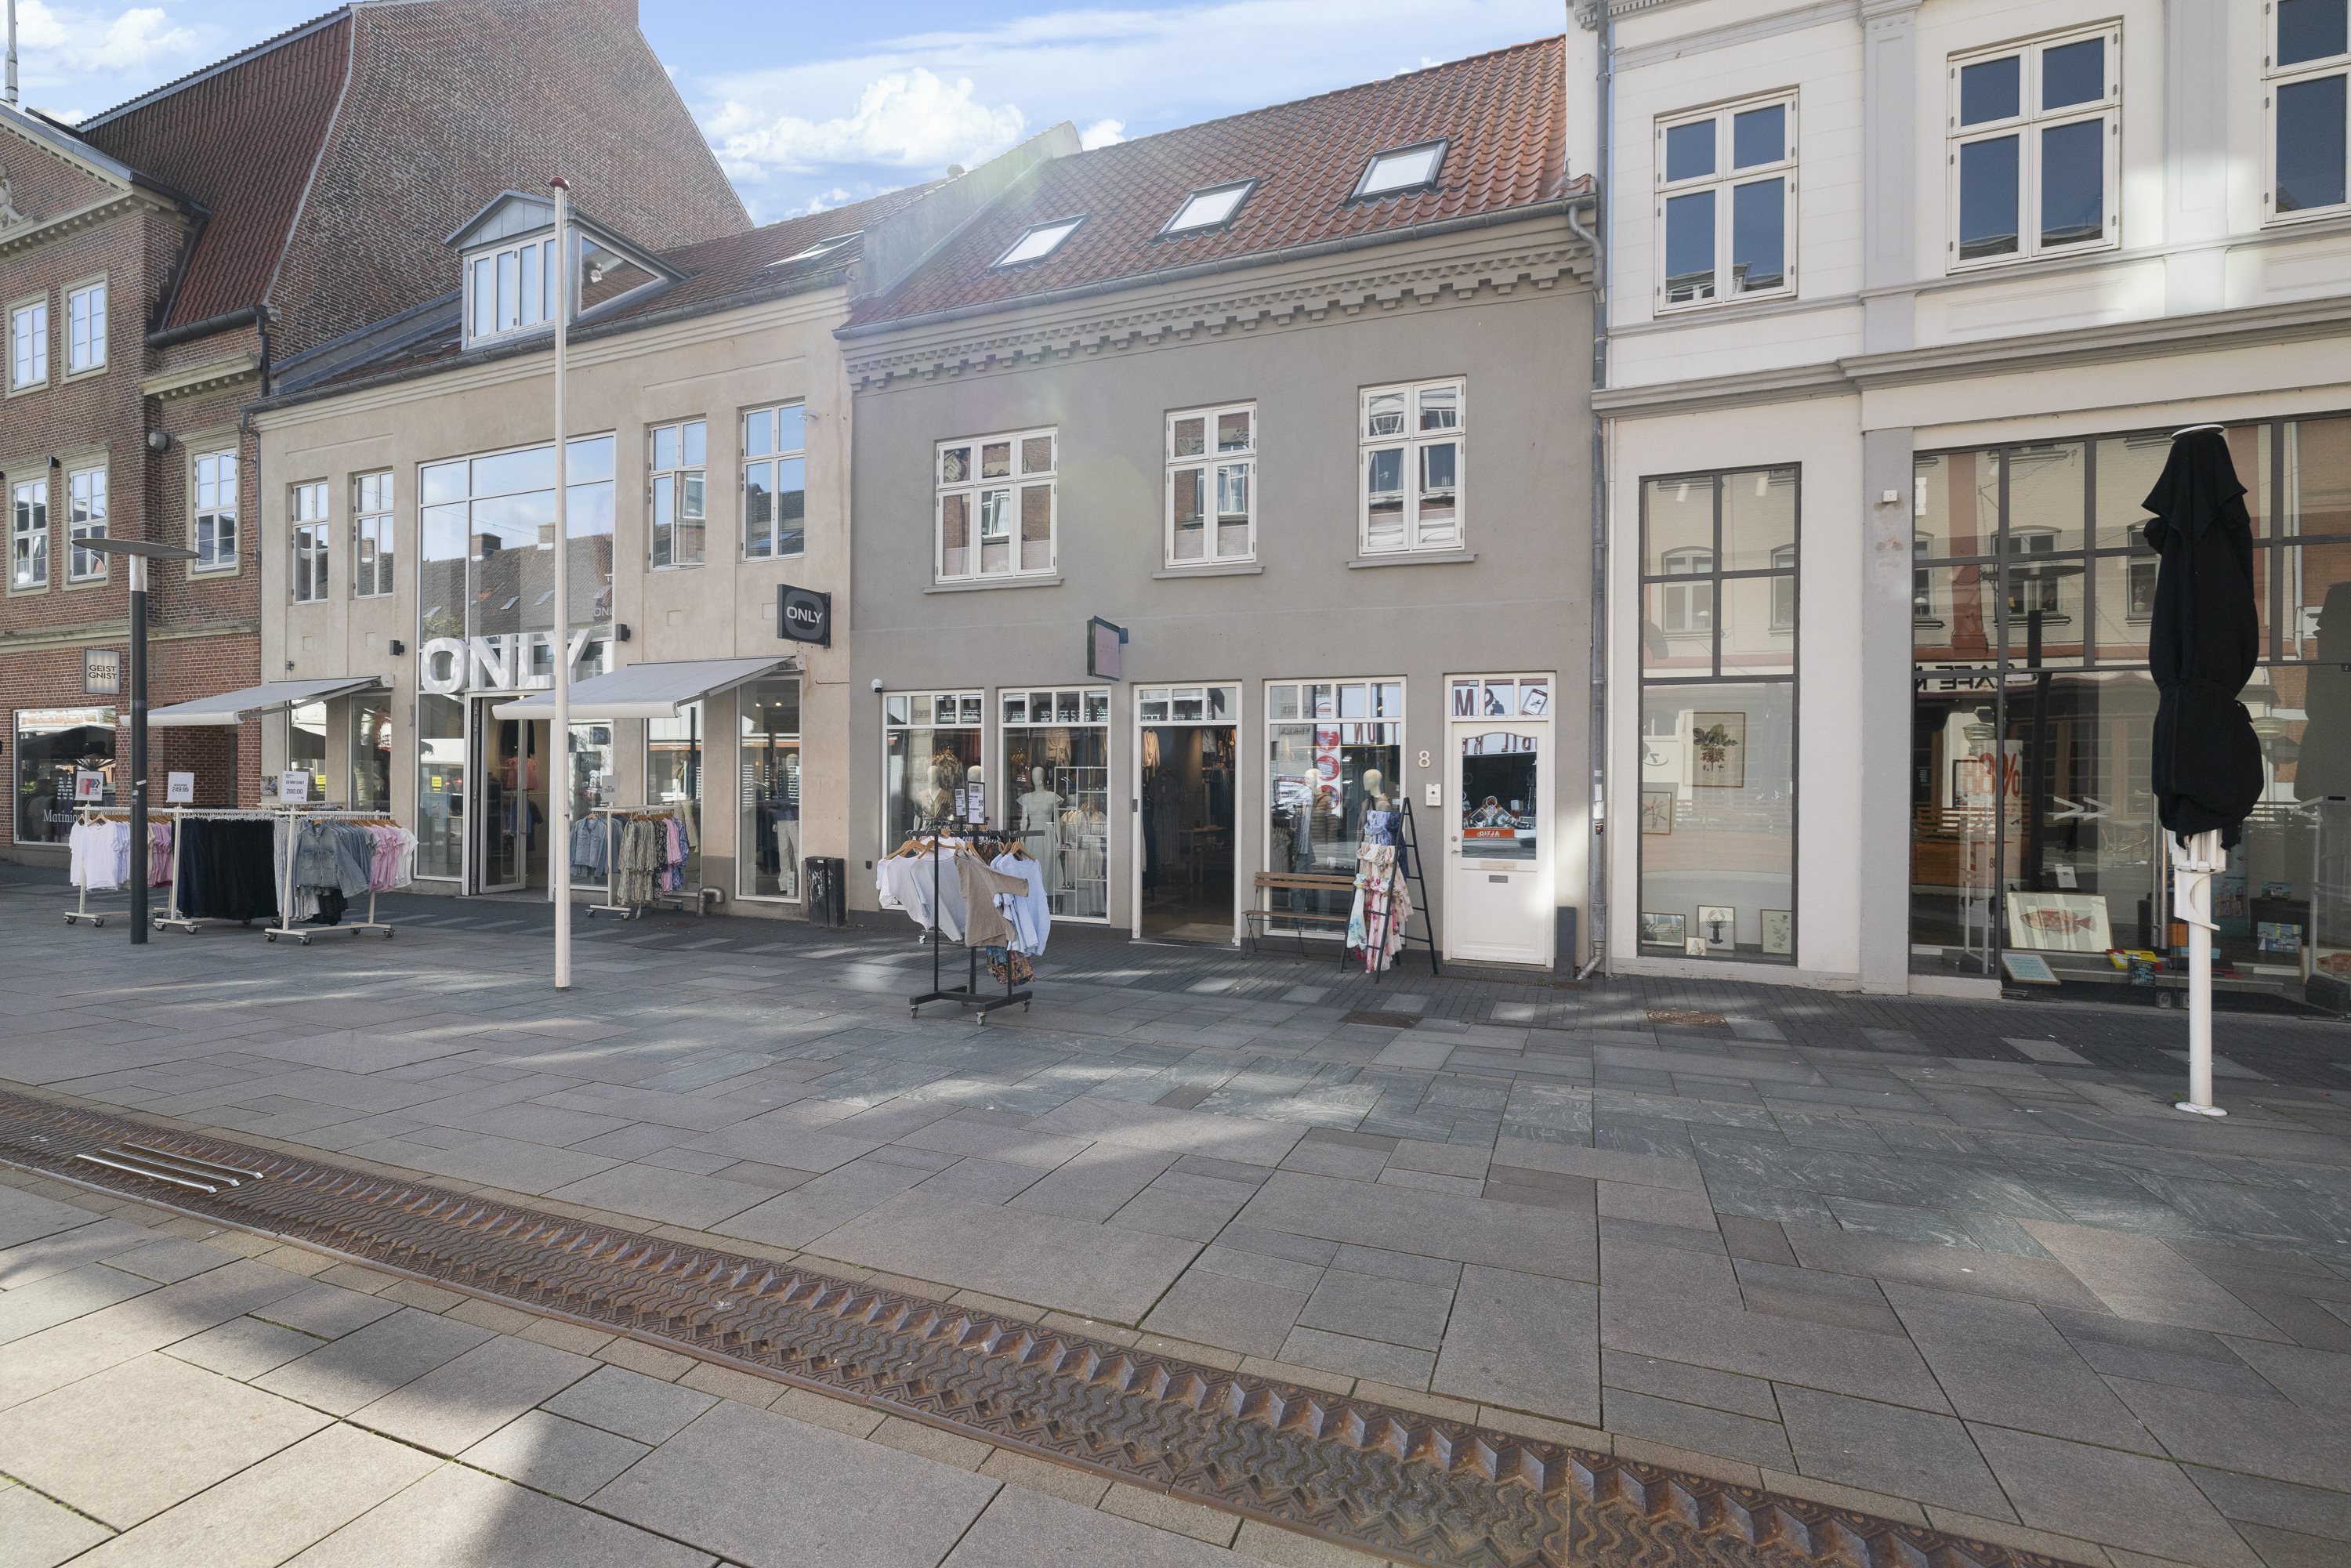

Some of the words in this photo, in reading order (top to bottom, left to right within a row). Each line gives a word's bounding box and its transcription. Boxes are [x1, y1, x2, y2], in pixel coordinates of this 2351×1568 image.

[786, 607, 823, 624] ONLY
[421, 629, 593, 694] ONLY
[1418, 750, 1431, 768] 8
